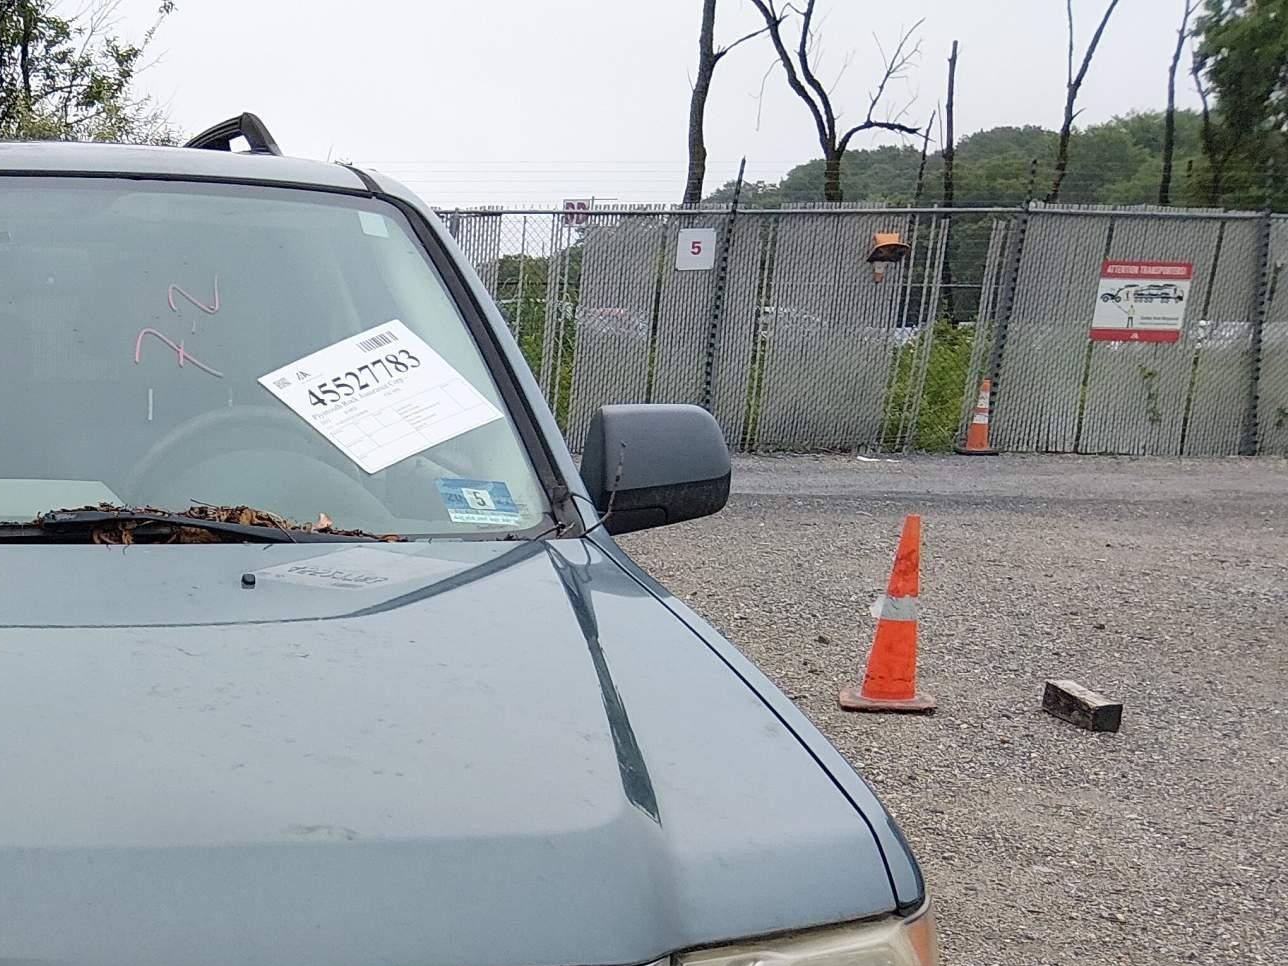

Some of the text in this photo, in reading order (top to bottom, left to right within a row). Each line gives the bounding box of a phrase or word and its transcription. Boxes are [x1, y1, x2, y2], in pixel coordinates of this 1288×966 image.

[691, 240, 702, 256] 5
[307, 349, 421, 407] 45527783
[473, 491, 487, 507] 5
